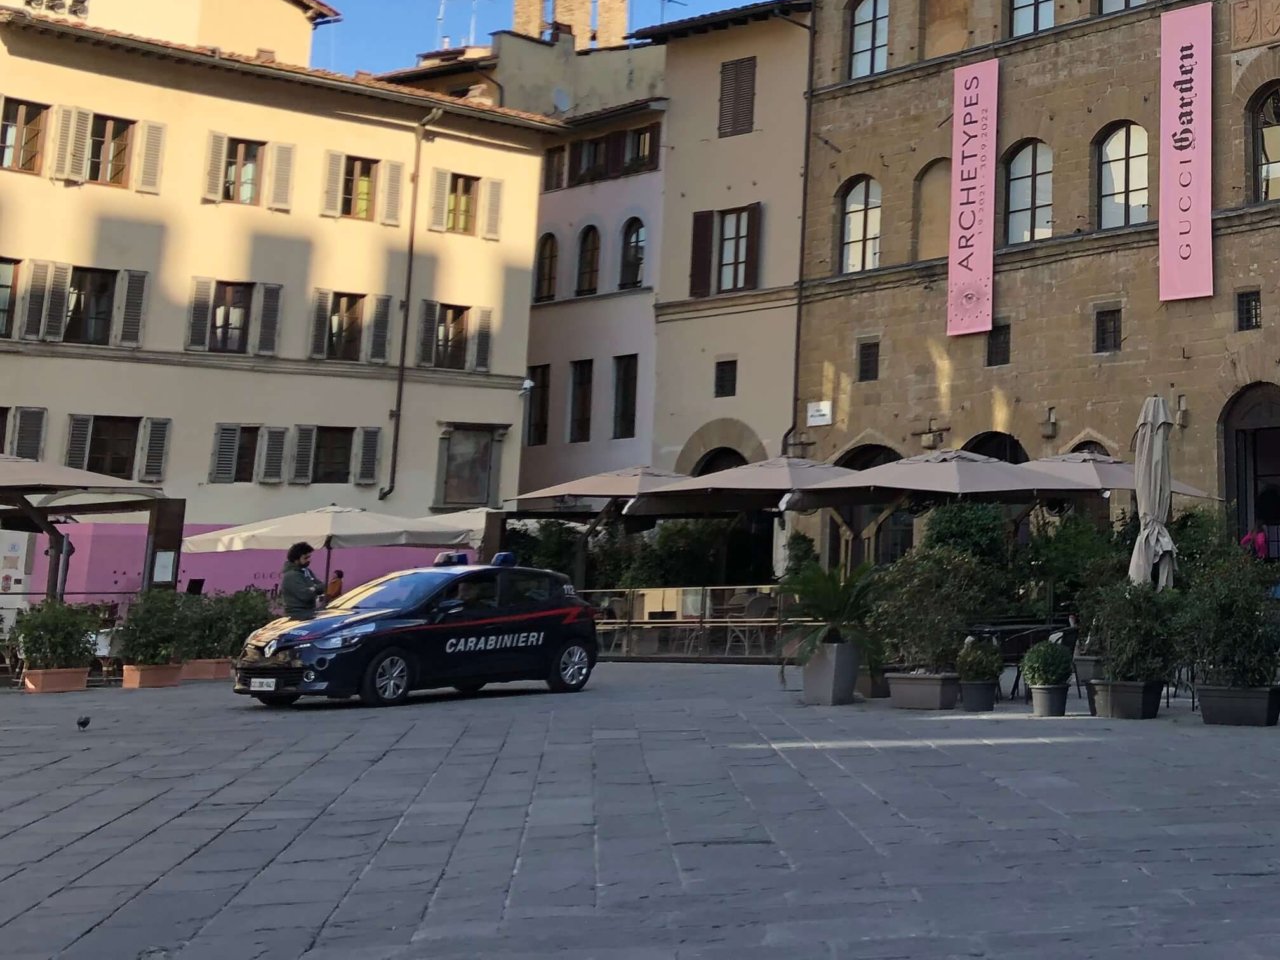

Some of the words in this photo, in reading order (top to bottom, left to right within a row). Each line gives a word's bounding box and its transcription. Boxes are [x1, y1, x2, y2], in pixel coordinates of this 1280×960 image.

[1171, 42, 1198, 152] Garden
[957, 75, 980, 272] ARCHETYPES
[1178, 158, 1193, 261] GUCCI
[562, 584, 577, 595] 112
[445, 631, 545, 654] CARABINIERI
